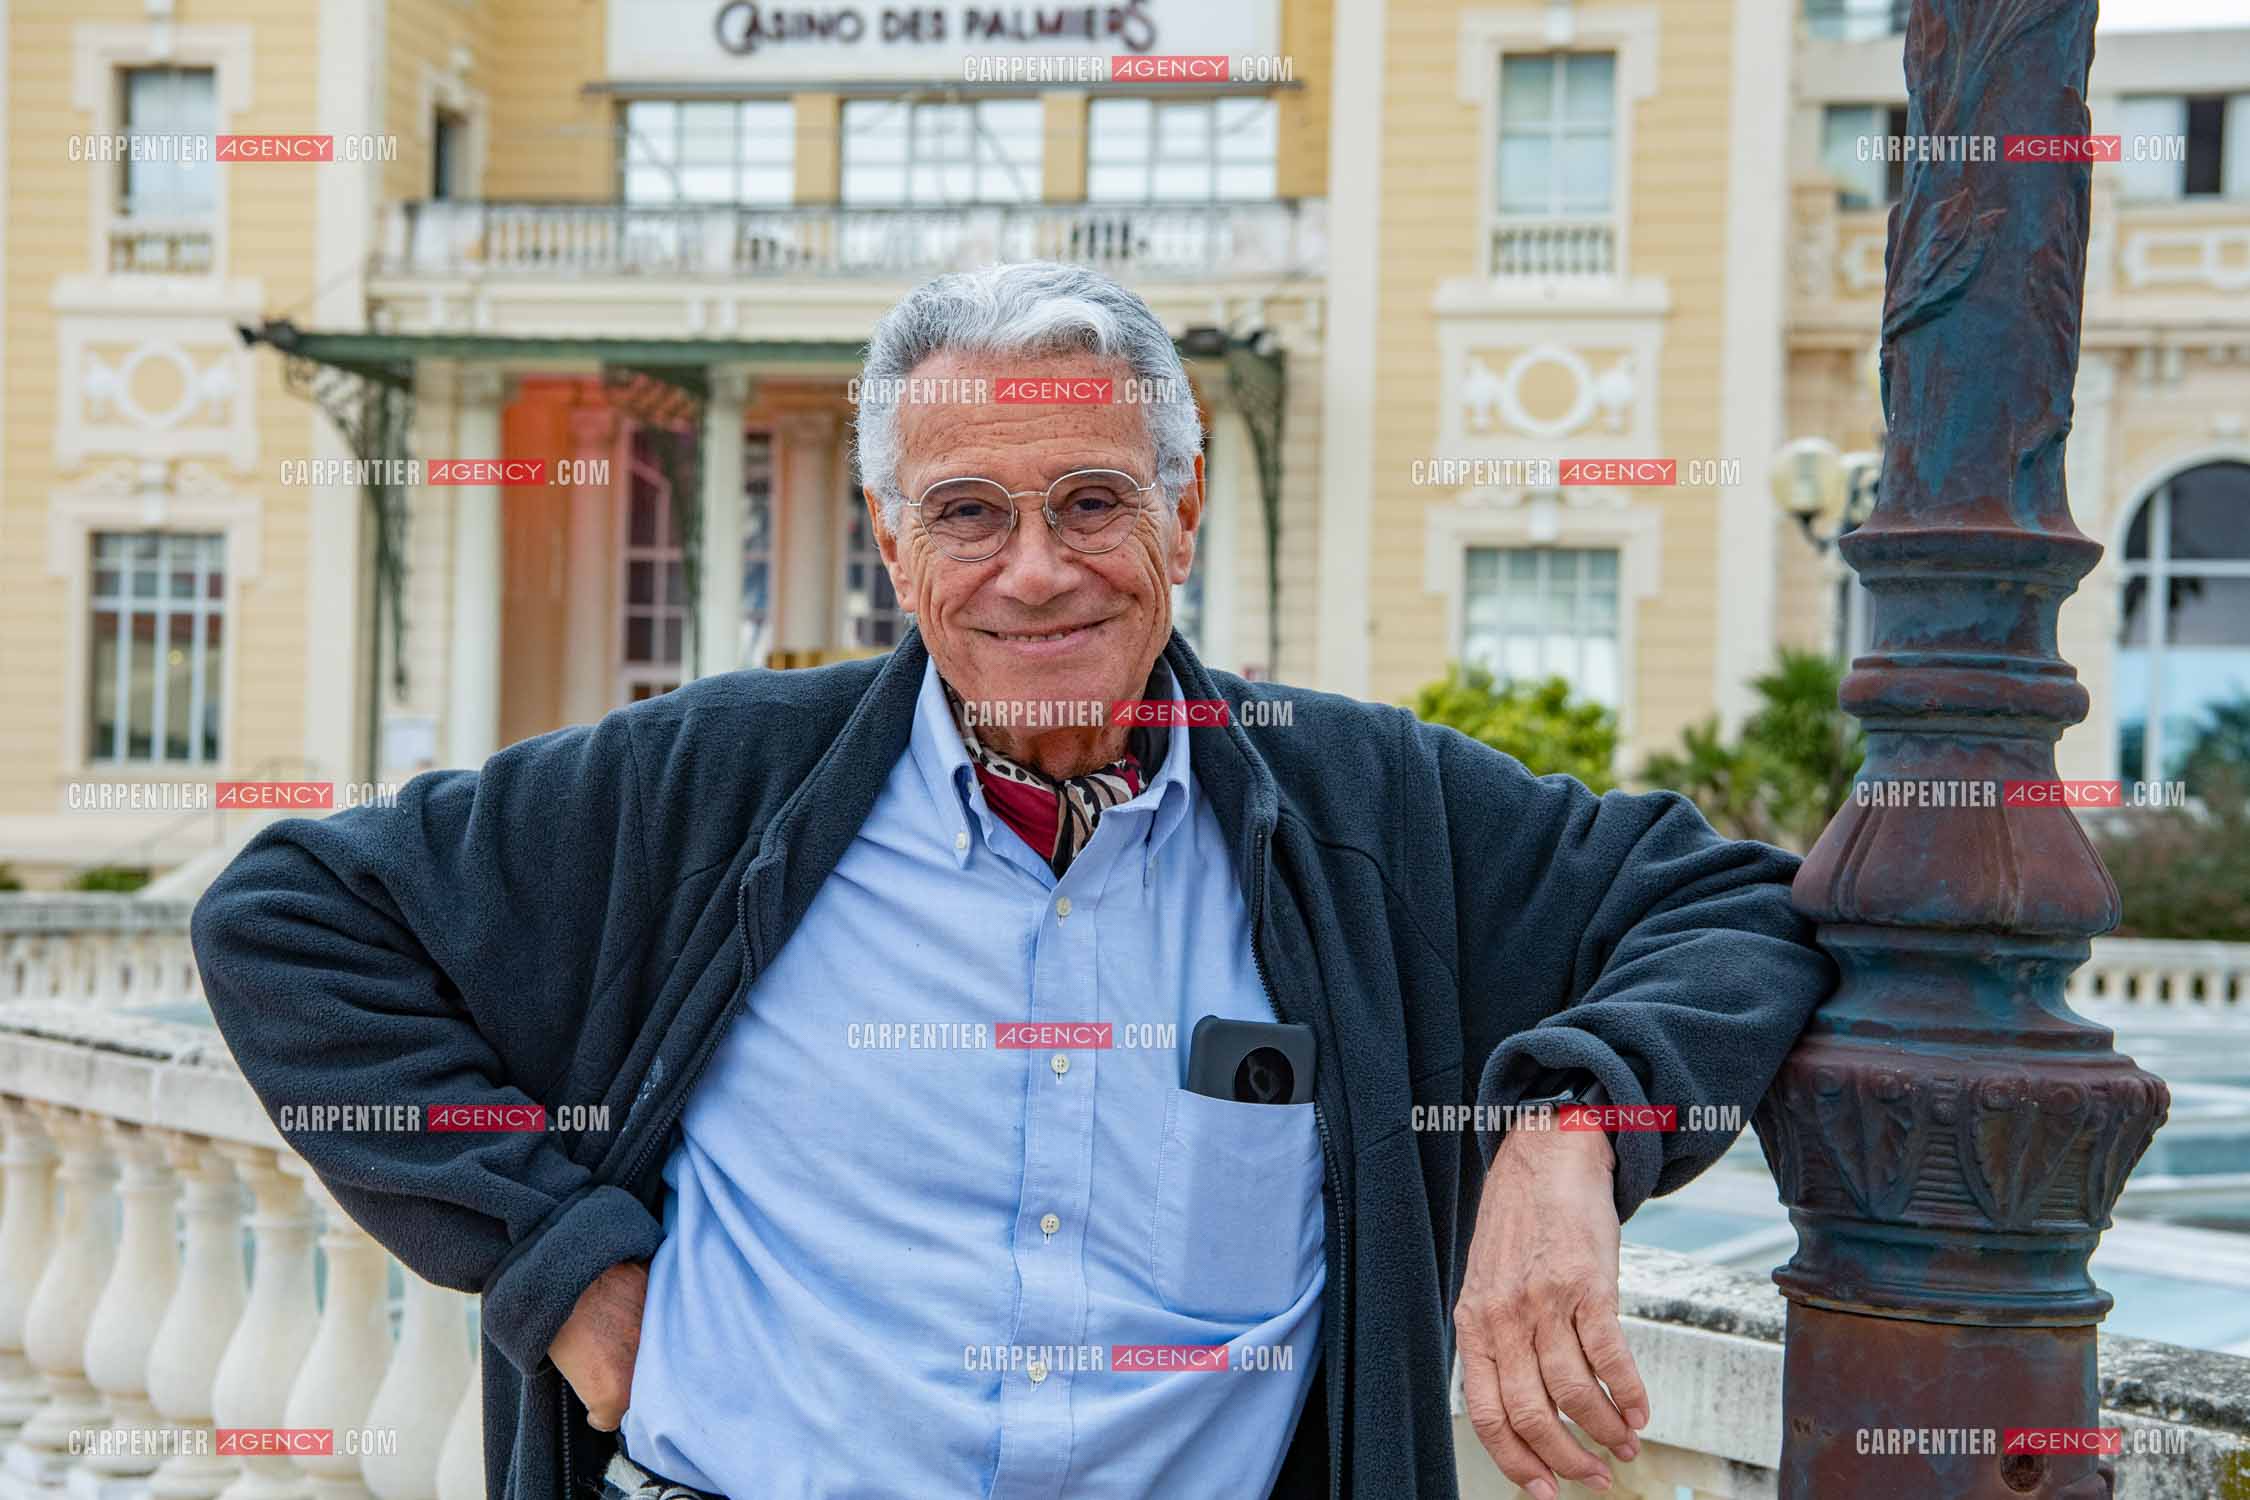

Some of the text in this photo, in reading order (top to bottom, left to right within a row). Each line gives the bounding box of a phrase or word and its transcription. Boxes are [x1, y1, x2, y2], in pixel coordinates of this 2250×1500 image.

[717, 0, 1156, 55] CASINO DES PALMIERS
